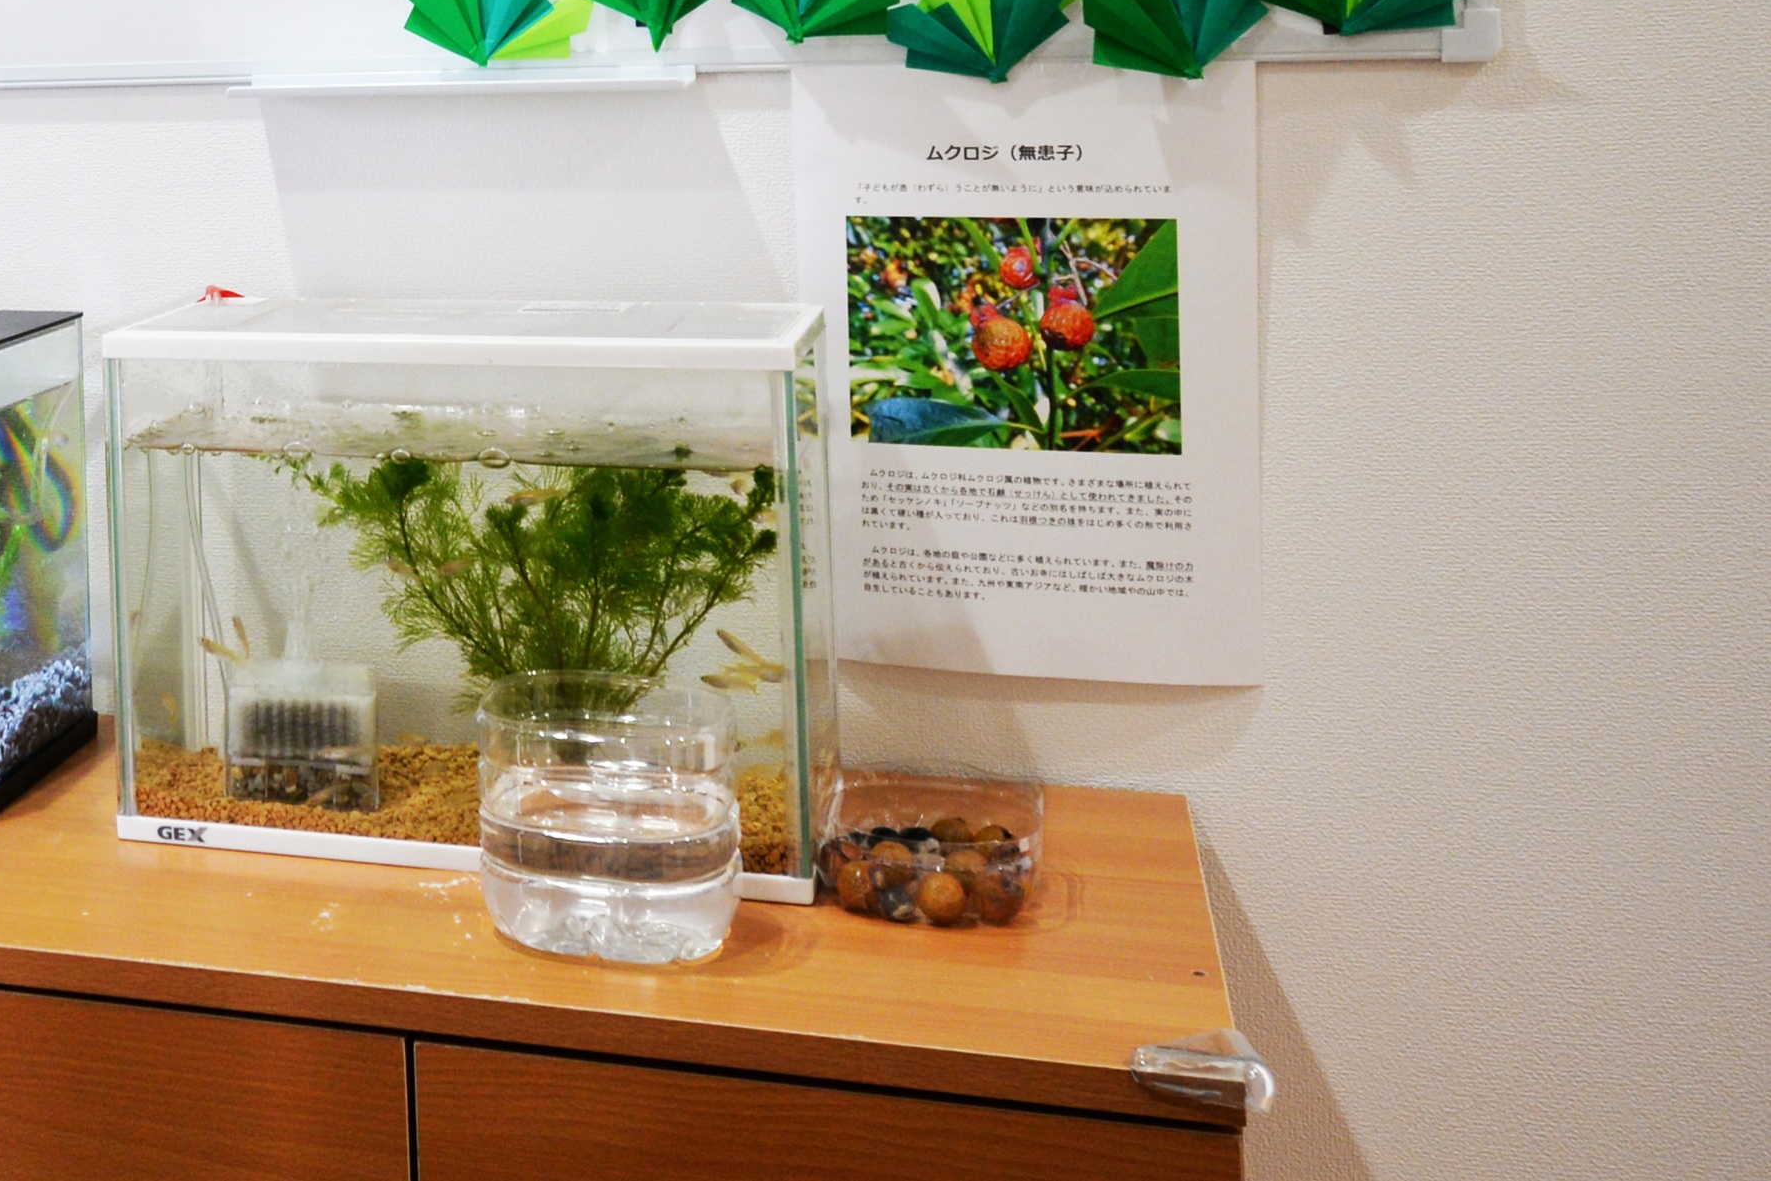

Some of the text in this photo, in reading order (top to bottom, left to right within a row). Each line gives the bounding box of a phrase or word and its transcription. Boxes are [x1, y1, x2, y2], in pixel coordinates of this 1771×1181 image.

[926, 144, 1084, 162] ムクロジ（無患子）
[862, 519, 910, 531] れています。
[157, 826, 209, 843] GEX
